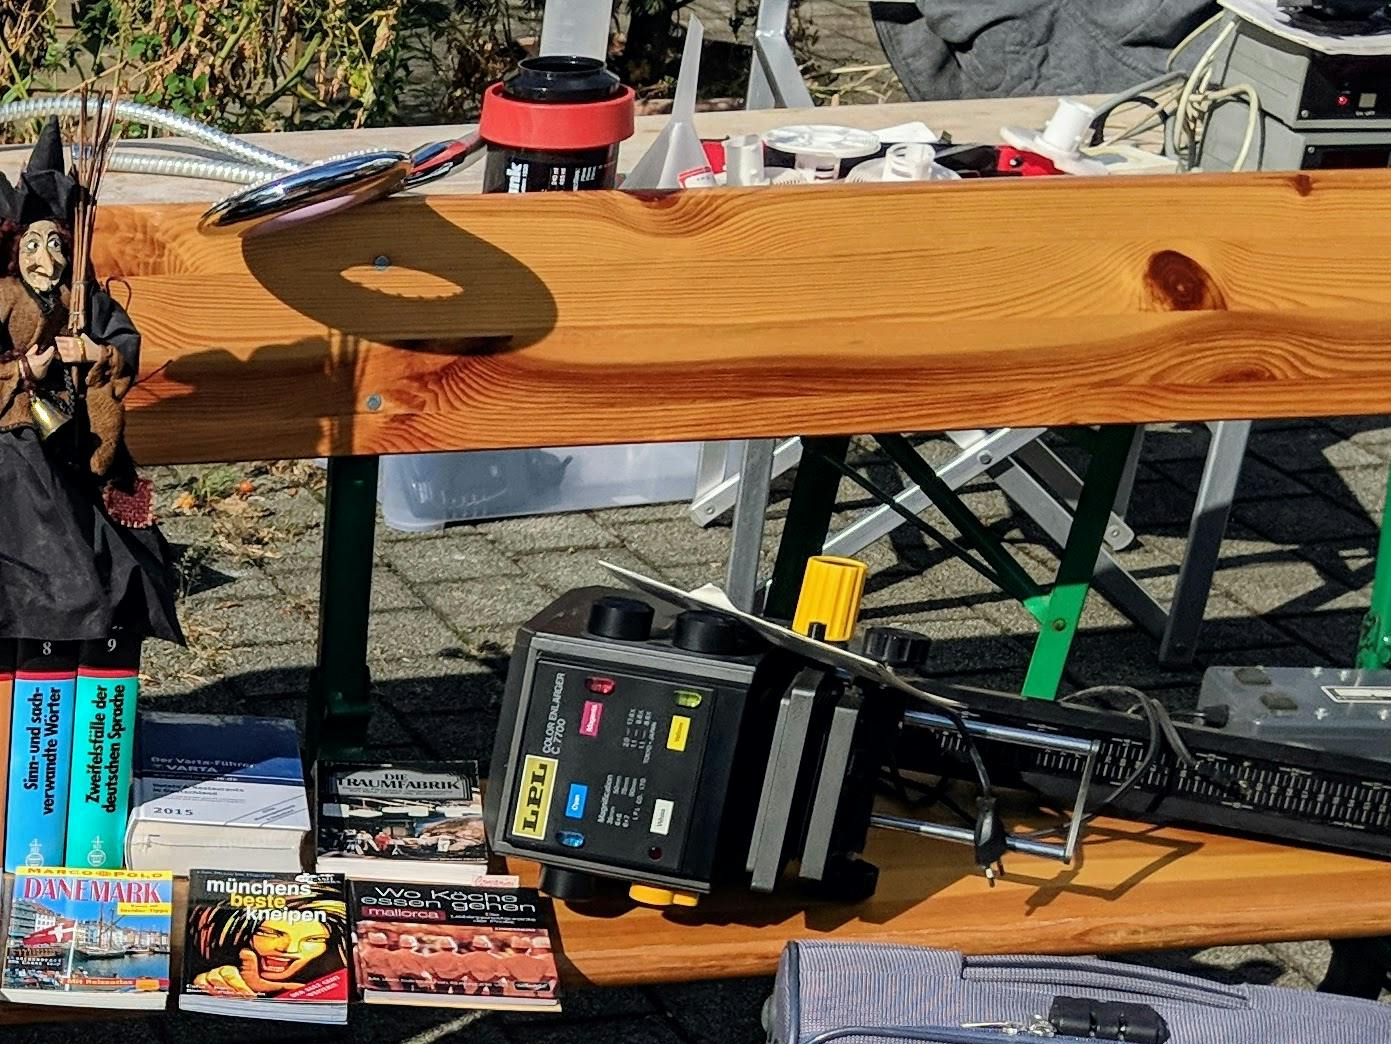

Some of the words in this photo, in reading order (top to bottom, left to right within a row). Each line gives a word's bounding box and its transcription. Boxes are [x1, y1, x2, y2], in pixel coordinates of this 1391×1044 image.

[42, 641, 52, 656] 8
[108, 638, 117, 652] 9
[48, 687, 62, 735] Wörter
[109, 684, 126, 739] Sprache
[542, 725, 555, 754] COLOR
[549, 672, 566, 721] ENLARGER
[553, 718, 567, 744] 7700
[85, 712, 105, 804] Zweifelsfälle
[97, 685, 108, 701] der
[551, 746, 561, 755] C
[42, 739, 57, 816] verwandte
[104, 741, 121, 814] deutschen
[166, 765, 218, 773] VARTA
[384, 773, 408, 781] DIE
[337, 778, 460, 790] TRAUMFABRIK
[522, 763, 548, 832] LPL
[597, 774, 614, 824] Magnification
[153, 807, 194, 816] 2015
[27, 868, 93, 877] MARCO
[23, 877, 162, 904] DÄNEMARK
[207, 878, 312, 896] münchens
[374, 887, 421, 898] Wo
[431, 890, 518, 903] Köche
[230, 893, 287, 908] beste
[361, 896, 441, 909] essen
[451, 900, 536, 913] gehen
[246, 907, 327, 925] kneipen
[368, 906, 439, 920] mallorca
